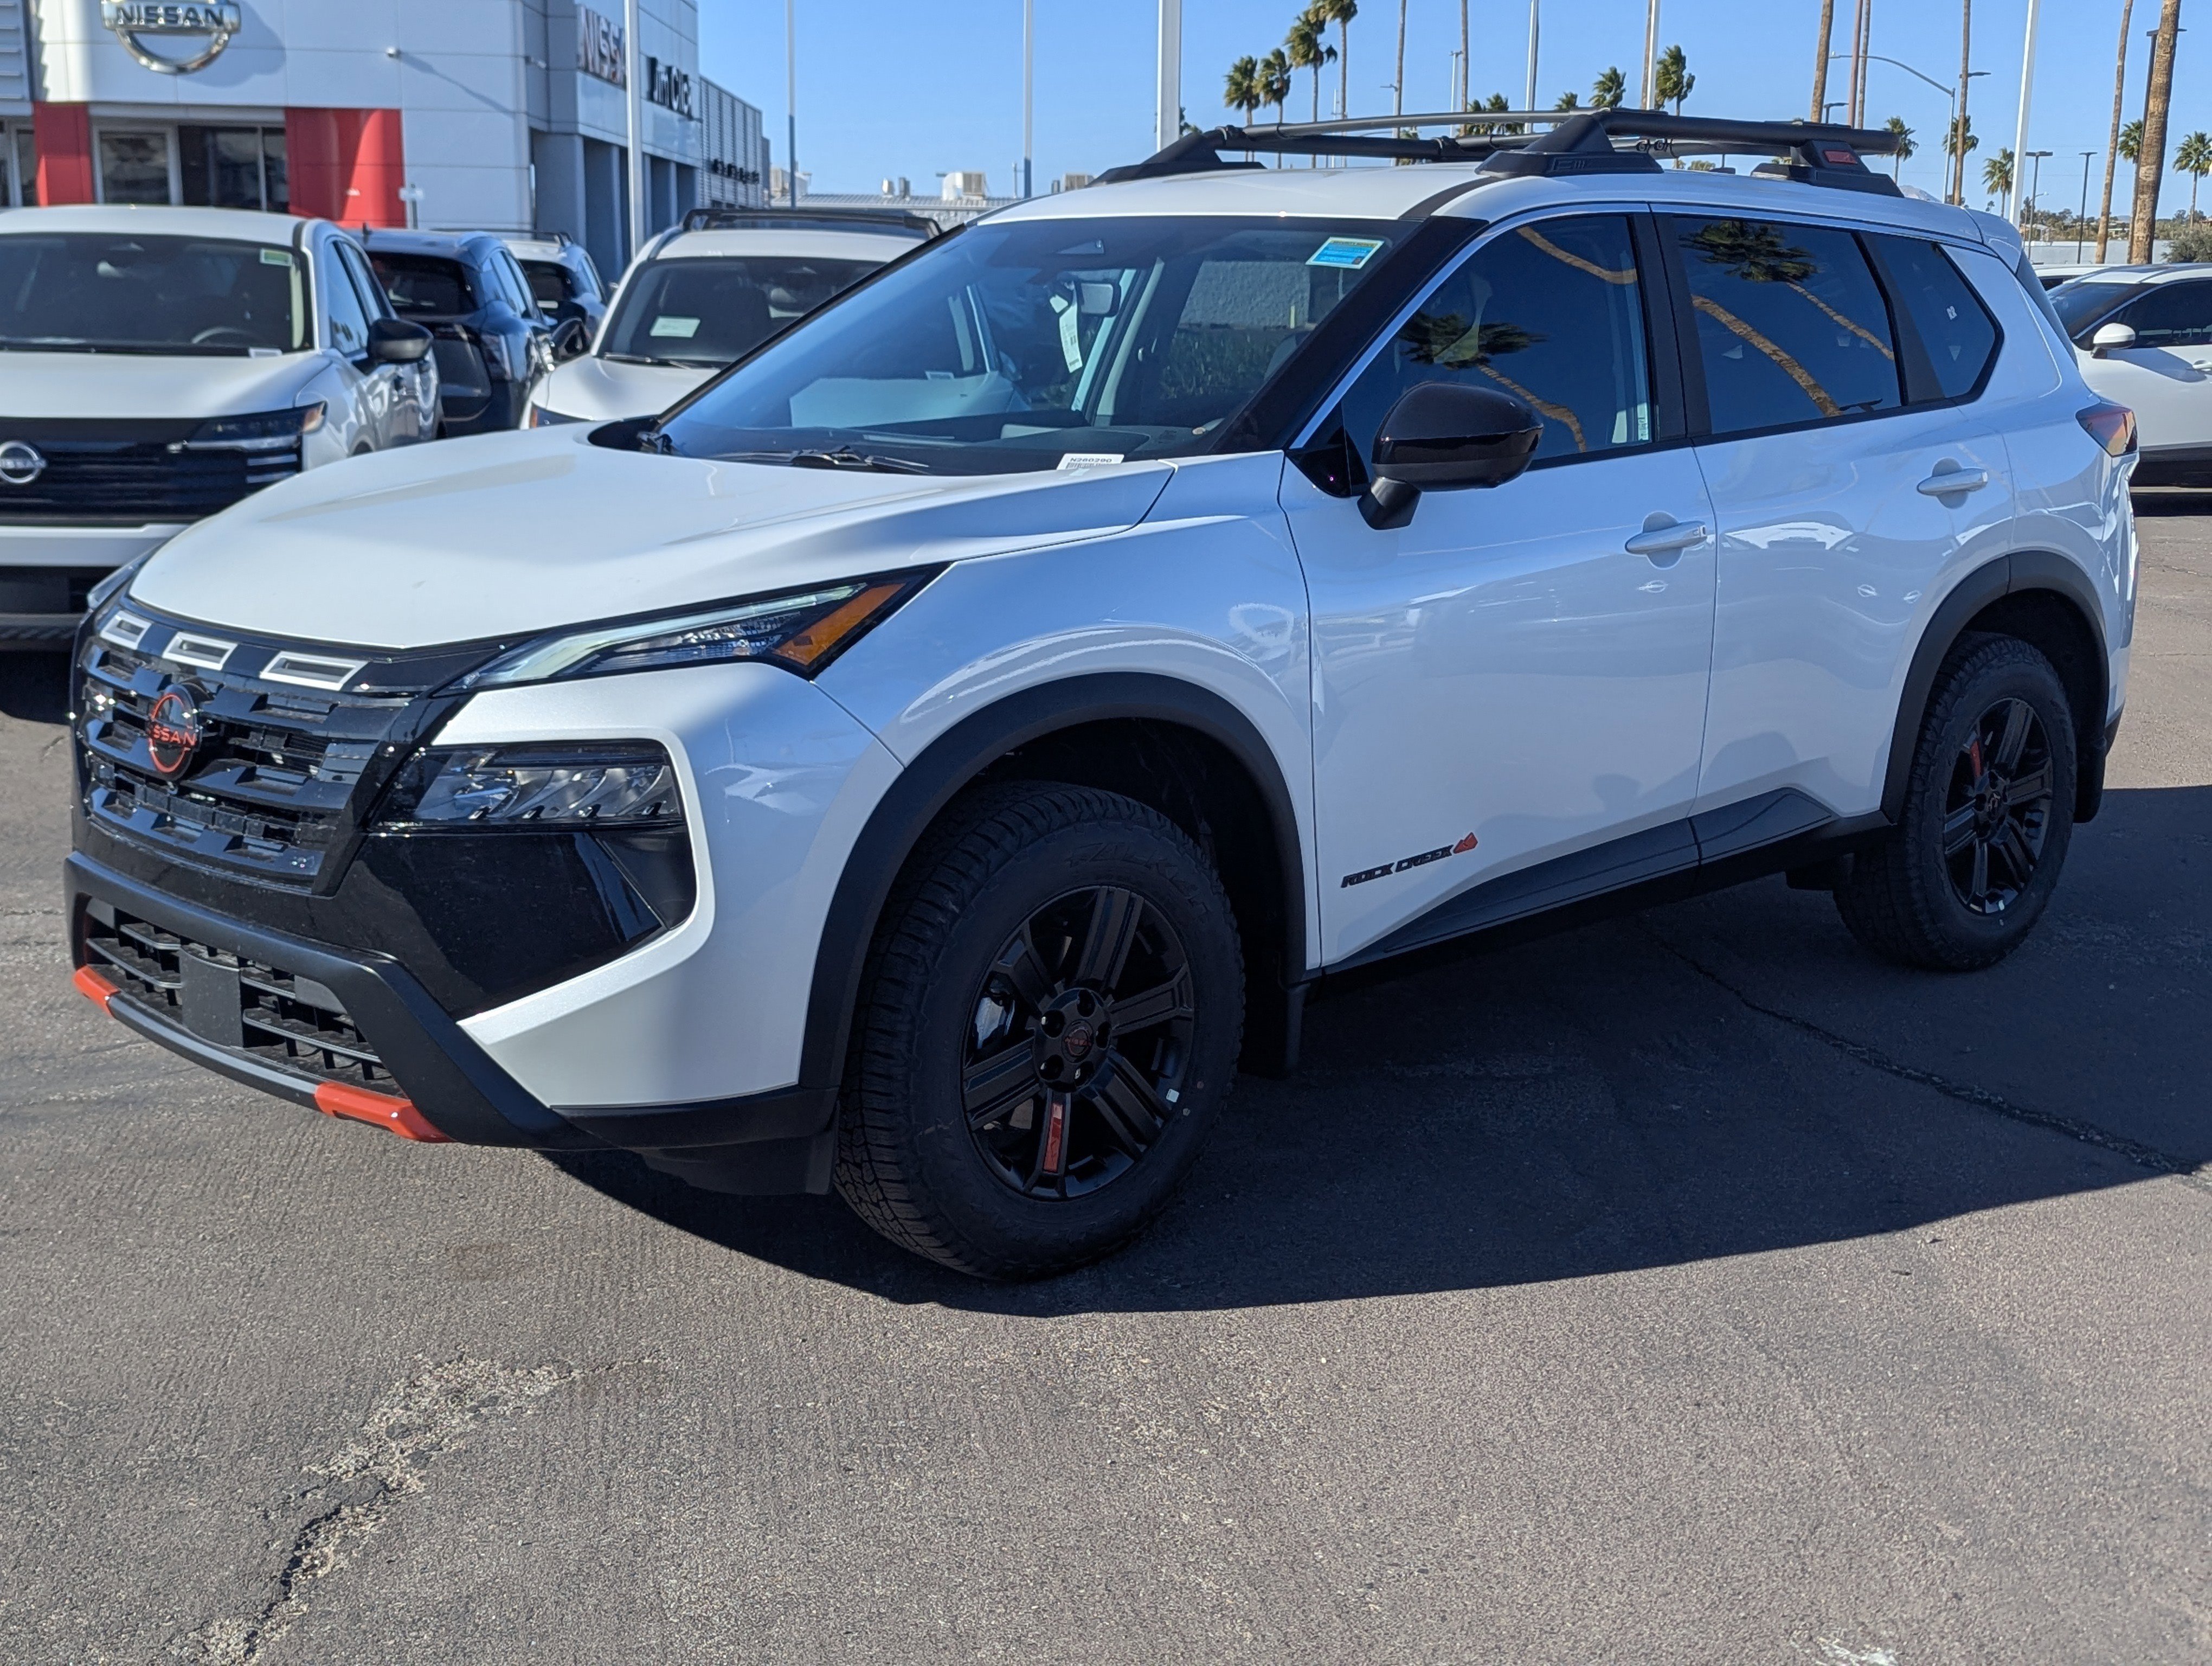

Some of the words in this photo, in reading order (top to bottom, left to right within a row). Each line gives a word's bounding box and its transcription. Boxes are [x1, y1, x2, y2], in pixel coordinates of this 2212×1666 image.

[116, 4, 223, 25] NISSAN
[1341, 862, 1394, 888] ROCK
[1395, 844, 1454, 873] CREEK
